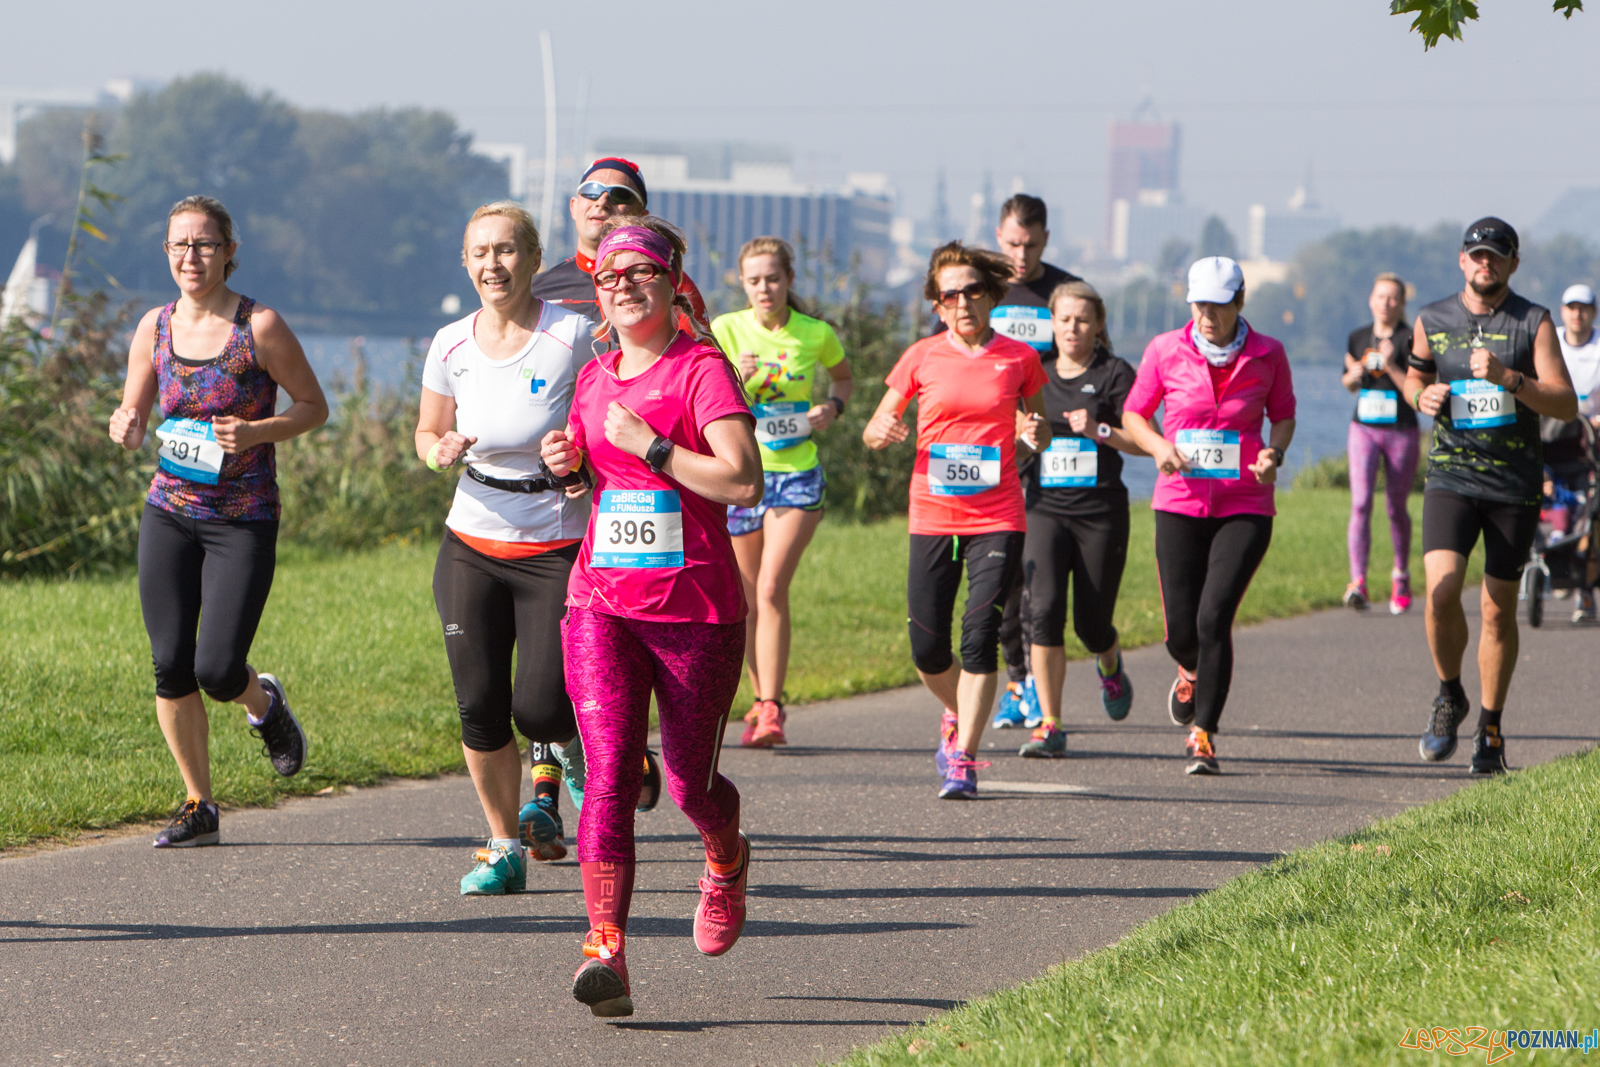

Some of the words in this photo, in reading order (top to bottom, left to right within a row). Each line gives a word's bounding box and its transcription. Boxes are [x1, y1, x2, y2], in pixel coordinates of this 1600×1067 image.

[1007, 323, 1036, 336] 409
[1467, 397, 1500, 414] 620
[766, 417, 798, 436] 055
[1052, 456, 1077, 471] 611
[1191, 448, 1223, 464] 473
[946, 464, 980, 481] 550
[611, 492, 655, 504] zaBIEGaj
[616, 504, 656, 512] FUNdusze
[609, 520, 656, 546] 396
